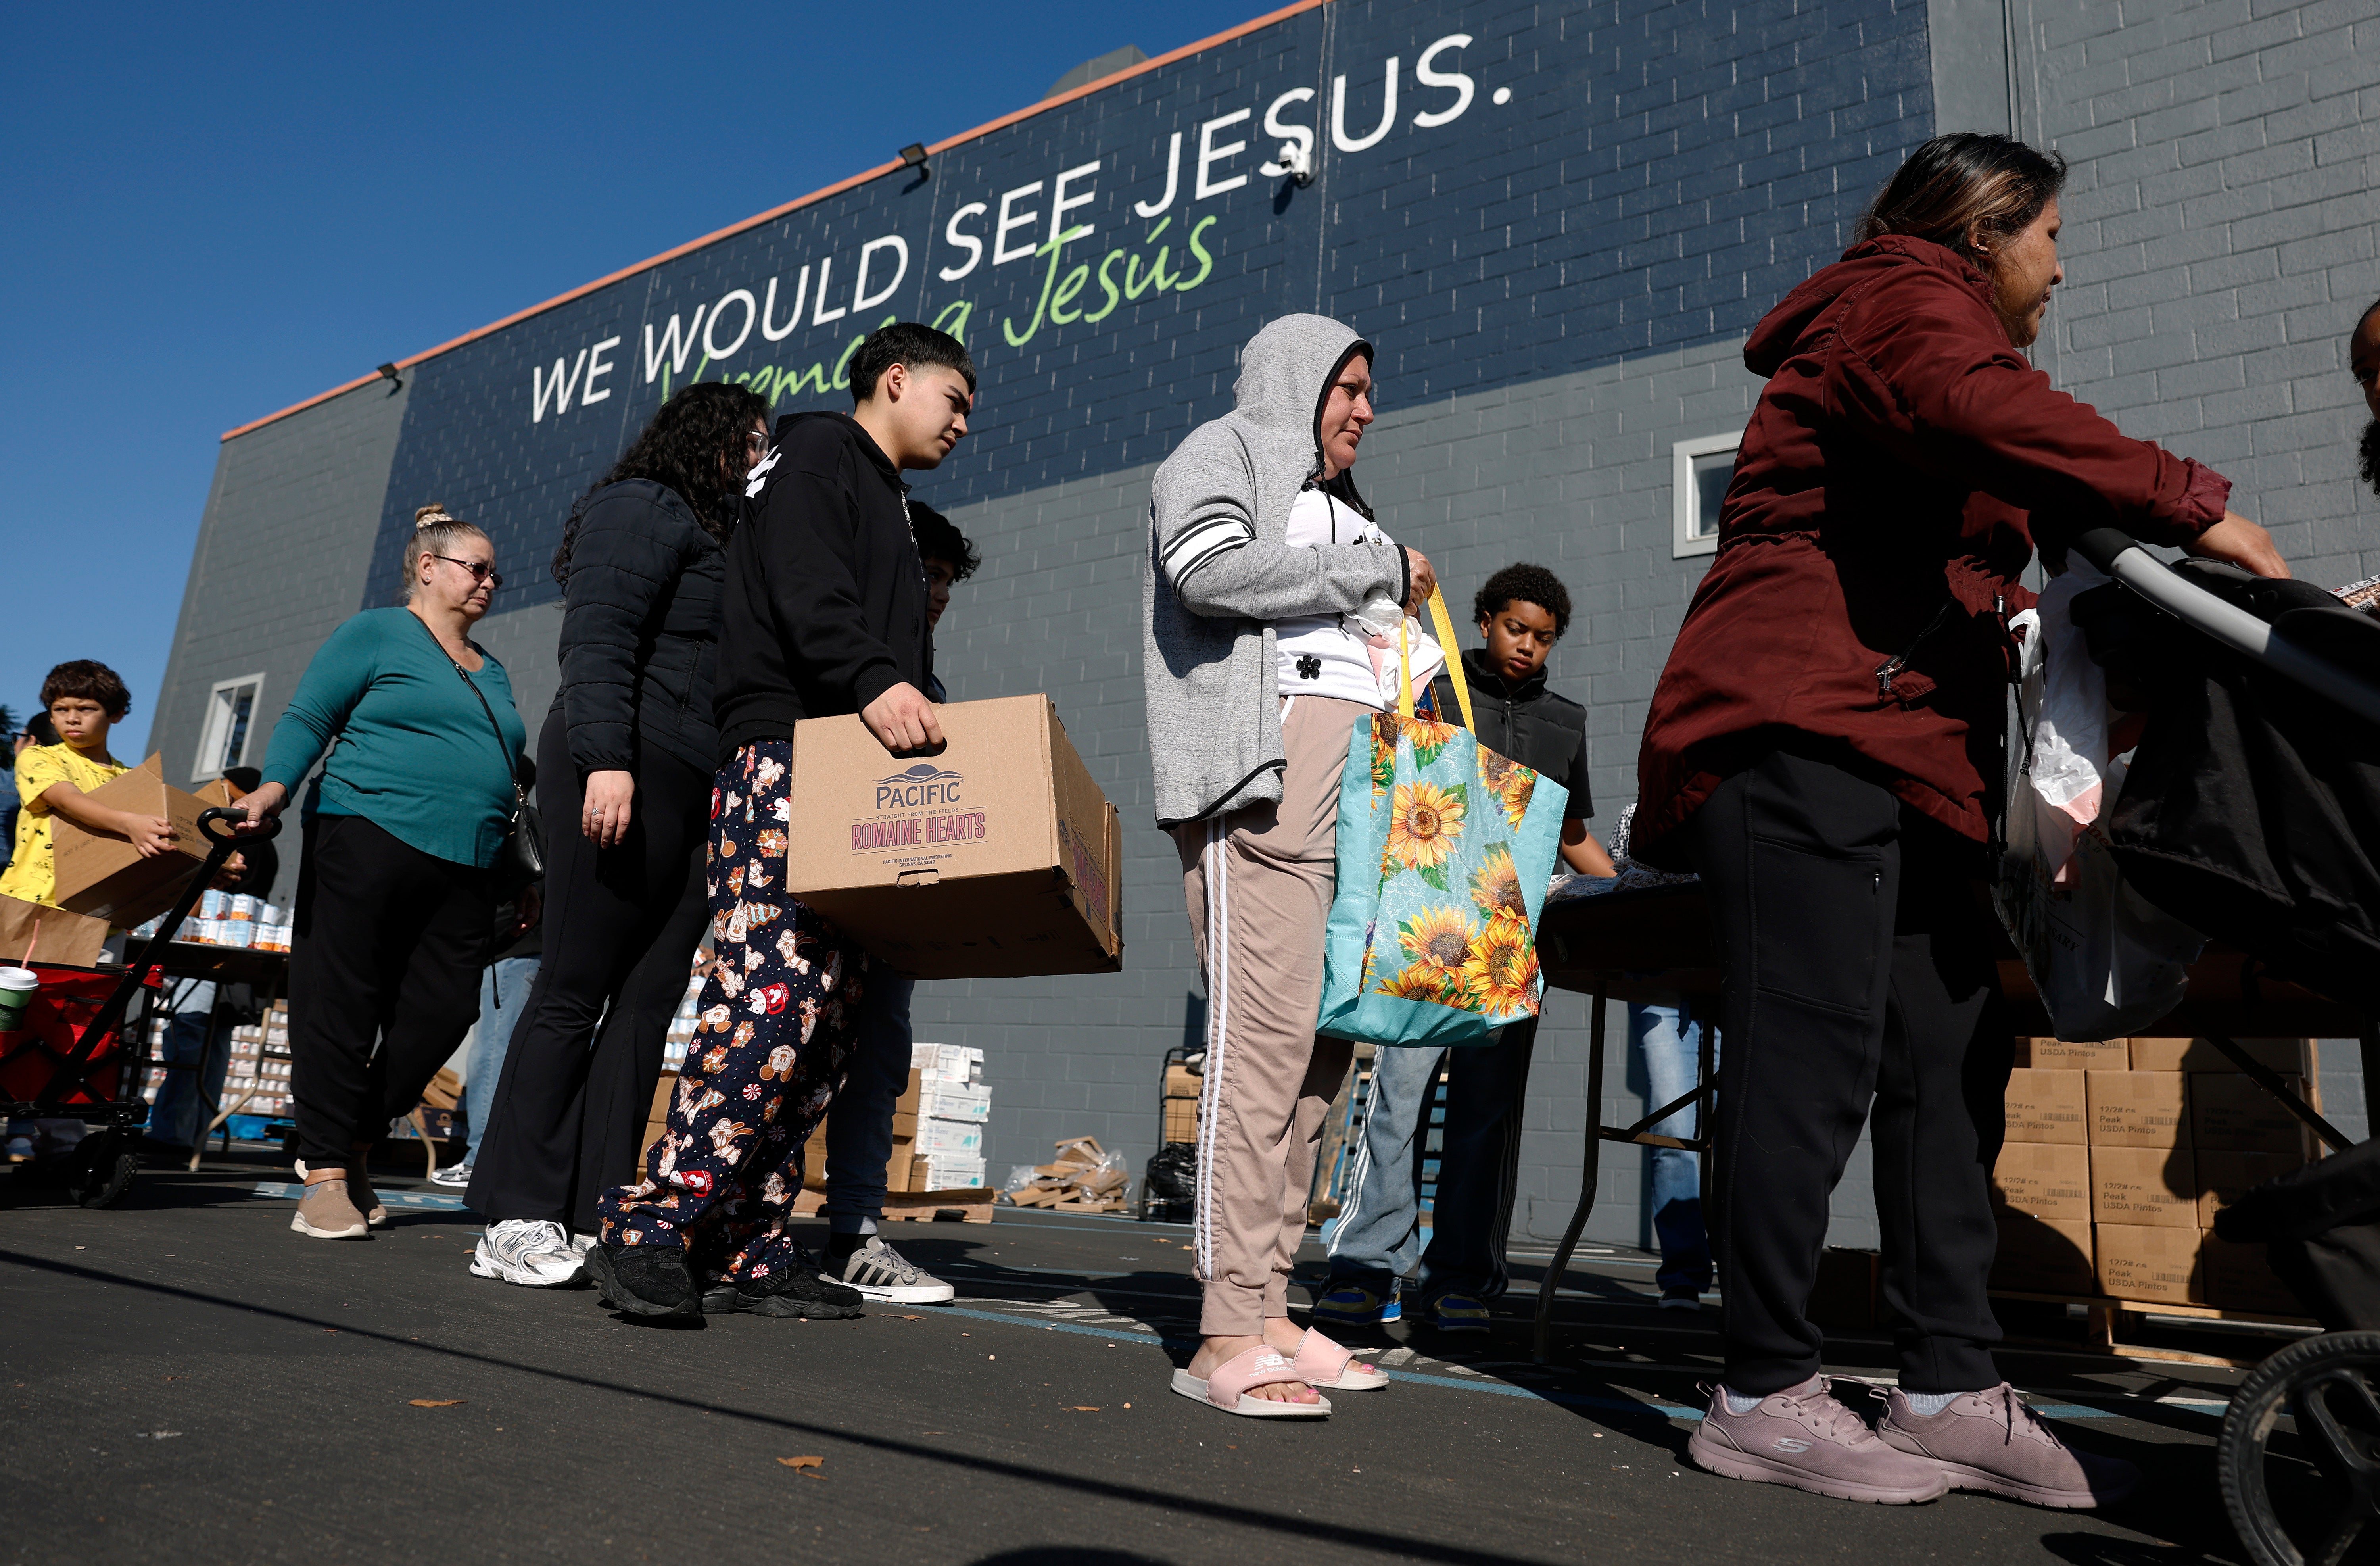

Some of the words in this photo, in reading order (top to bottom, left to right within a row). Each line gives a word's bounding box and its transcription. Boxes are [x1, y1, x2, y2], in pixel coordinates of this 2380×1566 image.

[533, 336, 620, 423] WE
[645, 235, 908, 383] WOULD
[939, 161, 1100, 281] SEE
[1134, 34, 1511, 218] JESUS.
[1005, 216, 1216, 345] Jesús
[876, 782, 960, 809] PACIFIC
[852, 818, 921, 850] ROMAINE
[926, 812, 985, 844] HEARTS
[2100, 1125, 2125, 1133] USDA
[2128, 1126, 2156, 1134] Pintos
[2031, 1197, 2058, 1206] Pintos
[2104, 1192, 2127, 1200] Peak
[2103, 1201, 2130, 1210] USDA
[2133, 1203, 2162, 1212] Pintos
[2109, 1268, 2132, 1278] Peak
[2108, 1278, 2136, 1288] USDA
[2138, 1280, 2168, 1291] Pintos
[1249, 1369, 1265, 1378] new
